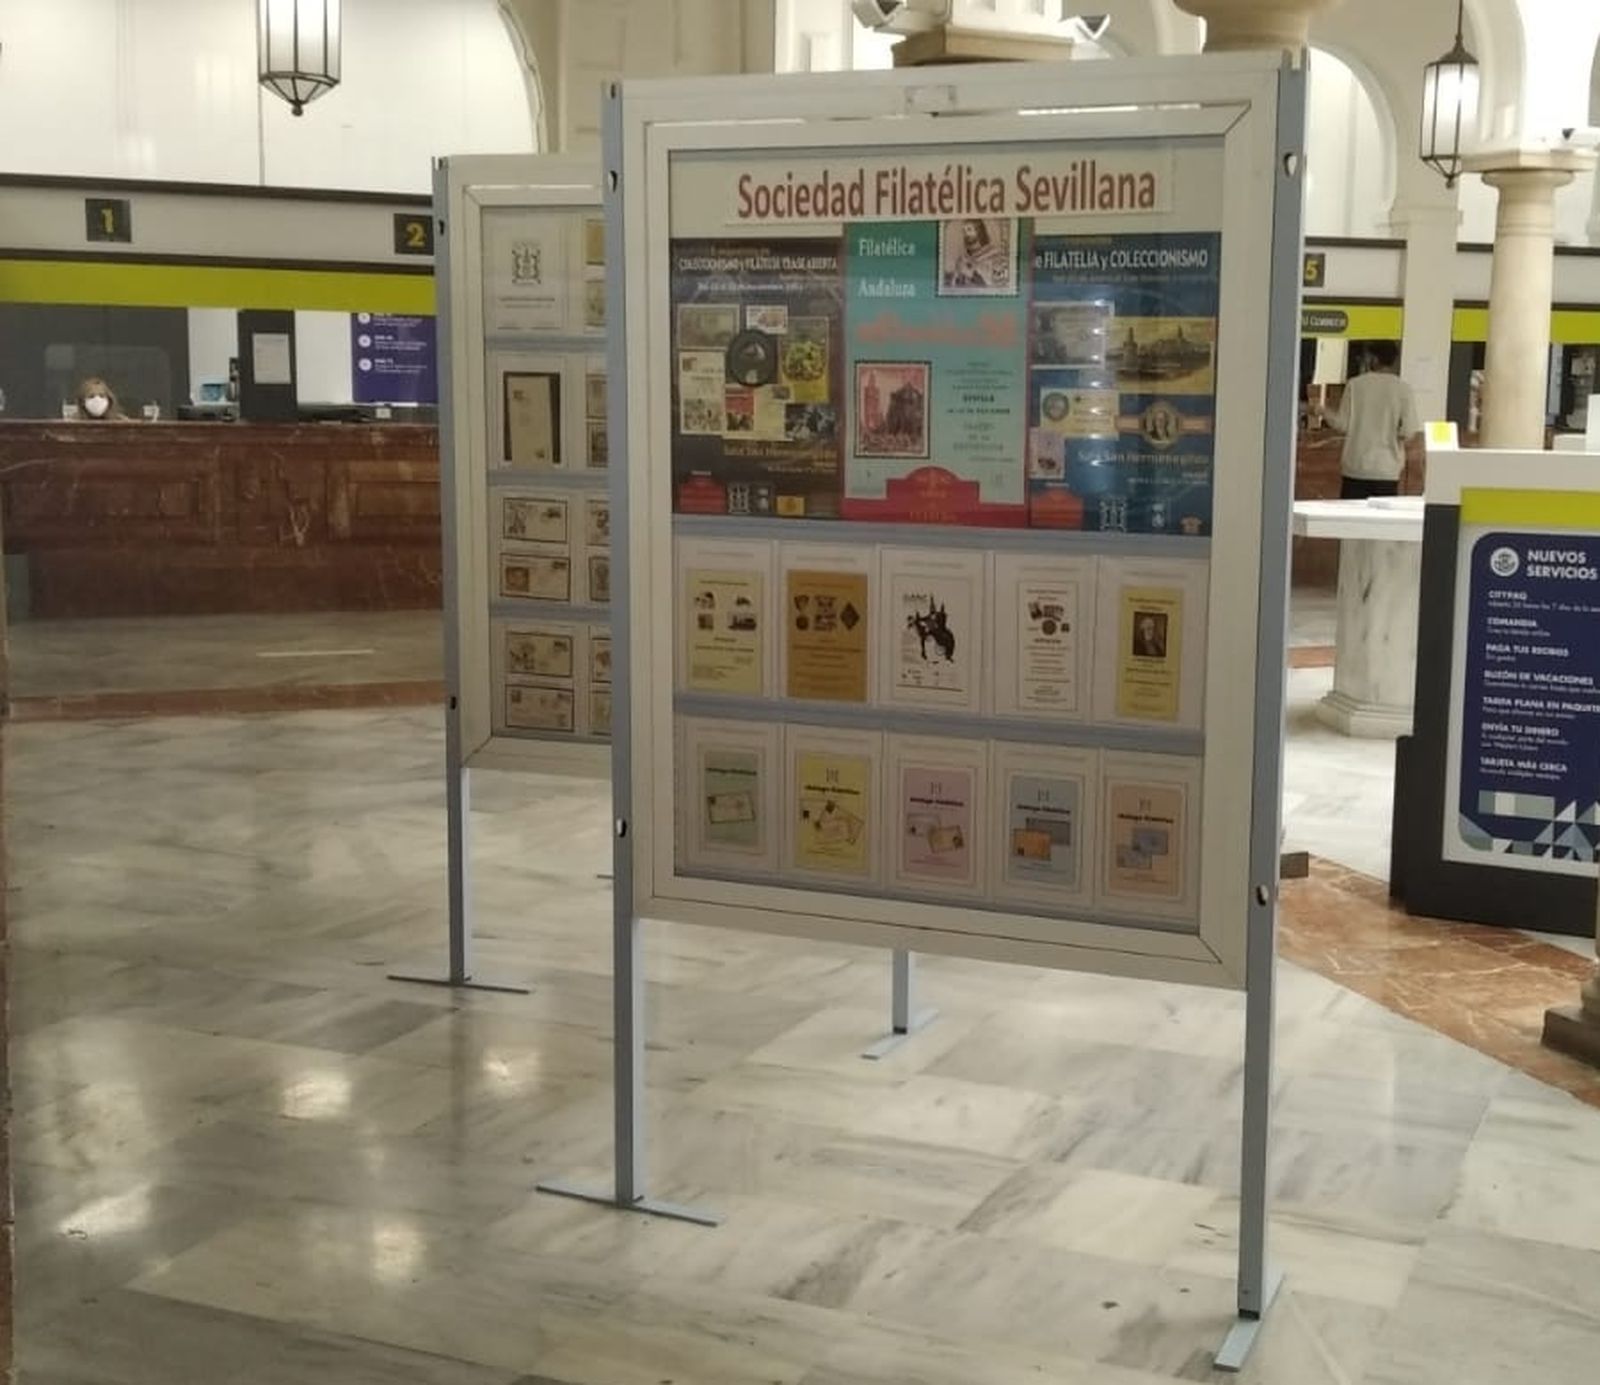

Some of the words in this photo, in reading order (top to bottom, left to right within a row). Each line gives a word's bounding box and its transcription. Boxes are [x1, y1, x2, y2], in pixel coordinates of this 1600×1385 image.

[738, 169, 864, 218] Sociedad
[875, 165, 1006, 216] Filatélica
[1015, 160, 1156, 212] Sevillana
[101, 209, 114, 233] 1
[406, 223, 425, 247] 2
[859, 237, 915, 256] Filatélica
[1044, 251, 1099, 269] FILATELIA
[1099, 255, 1107, 270] y
[1110, 249, 1208, 268] COLECCIONISMO
[1305, 260, 1318, 280] 5
[858, 278, 915, 298] Andaluza
[1527, 549, 1586, 564] NUEVOS
[1526, 565, 1598, 580] SERVICIOS
